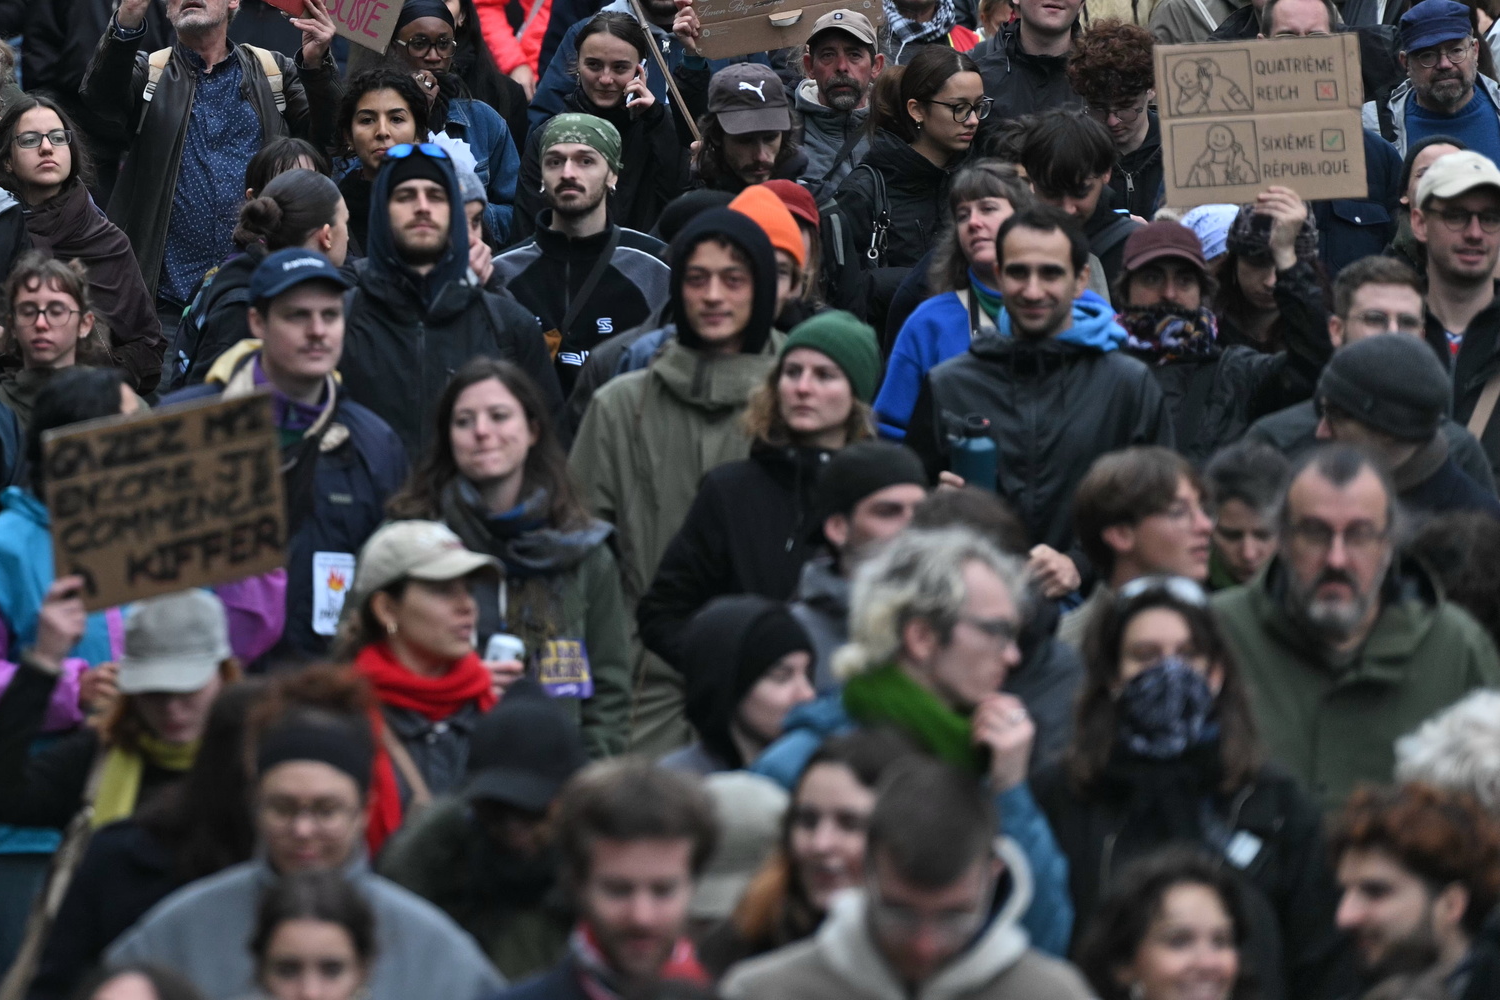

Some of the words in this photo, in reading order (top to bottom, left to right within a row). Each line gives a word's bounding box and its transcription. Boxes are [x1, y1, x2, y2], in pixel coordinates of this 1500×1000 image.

[1255, 55, 1335, 76] QUATRIÈME
[1256, 85, 1299, 101] REICH
[51, 418, 186, 479] GAZEZ
[54, 459, 198, 519] ENCORE
[62, 489, 274, 553] COMMENCE
[126, 514, 284, 585] KIFFER
